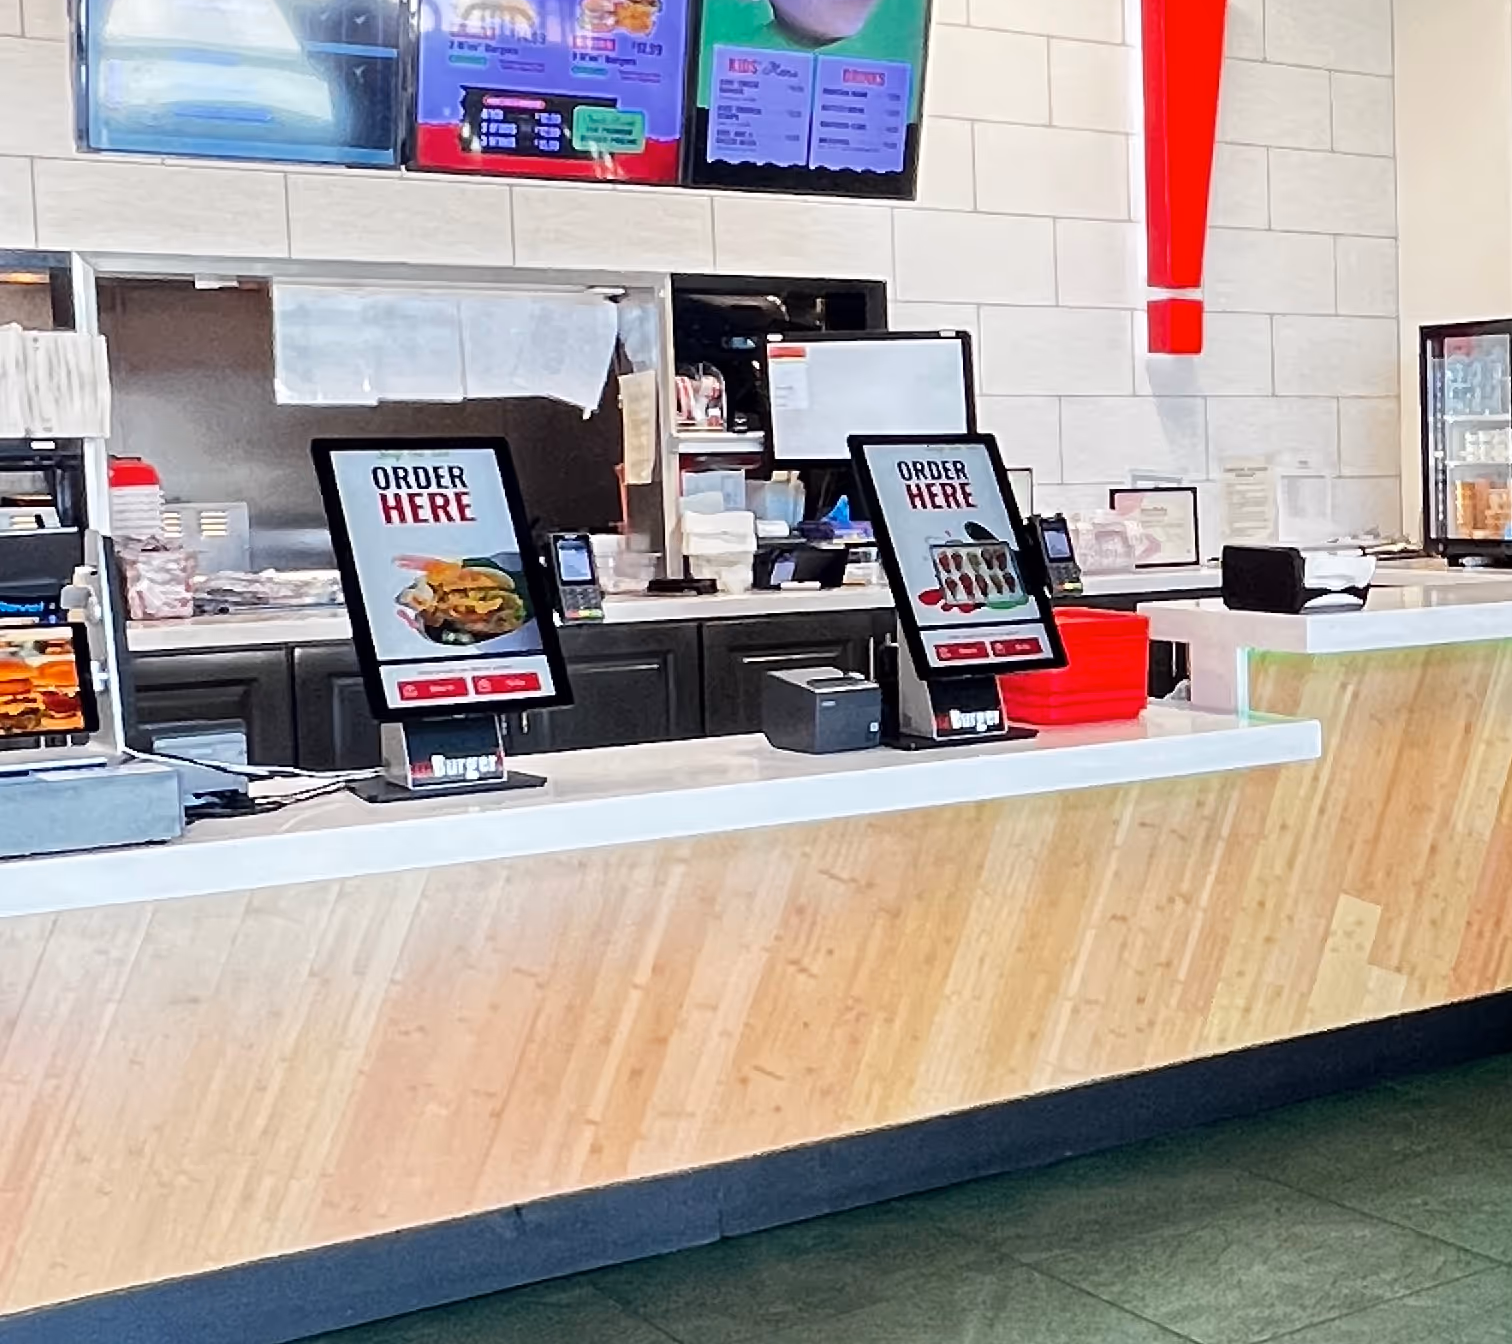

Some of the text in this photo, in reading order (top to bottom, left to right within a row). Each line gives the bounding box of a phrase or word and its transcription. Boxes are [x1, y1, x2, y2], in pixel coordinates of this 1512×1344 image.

[371, 464, 469, 491] ORDER
[896, 459, 970, 482] ORDER
[378, 491, 478, 525] HERE
[905, 482, 979, 510] HERE
